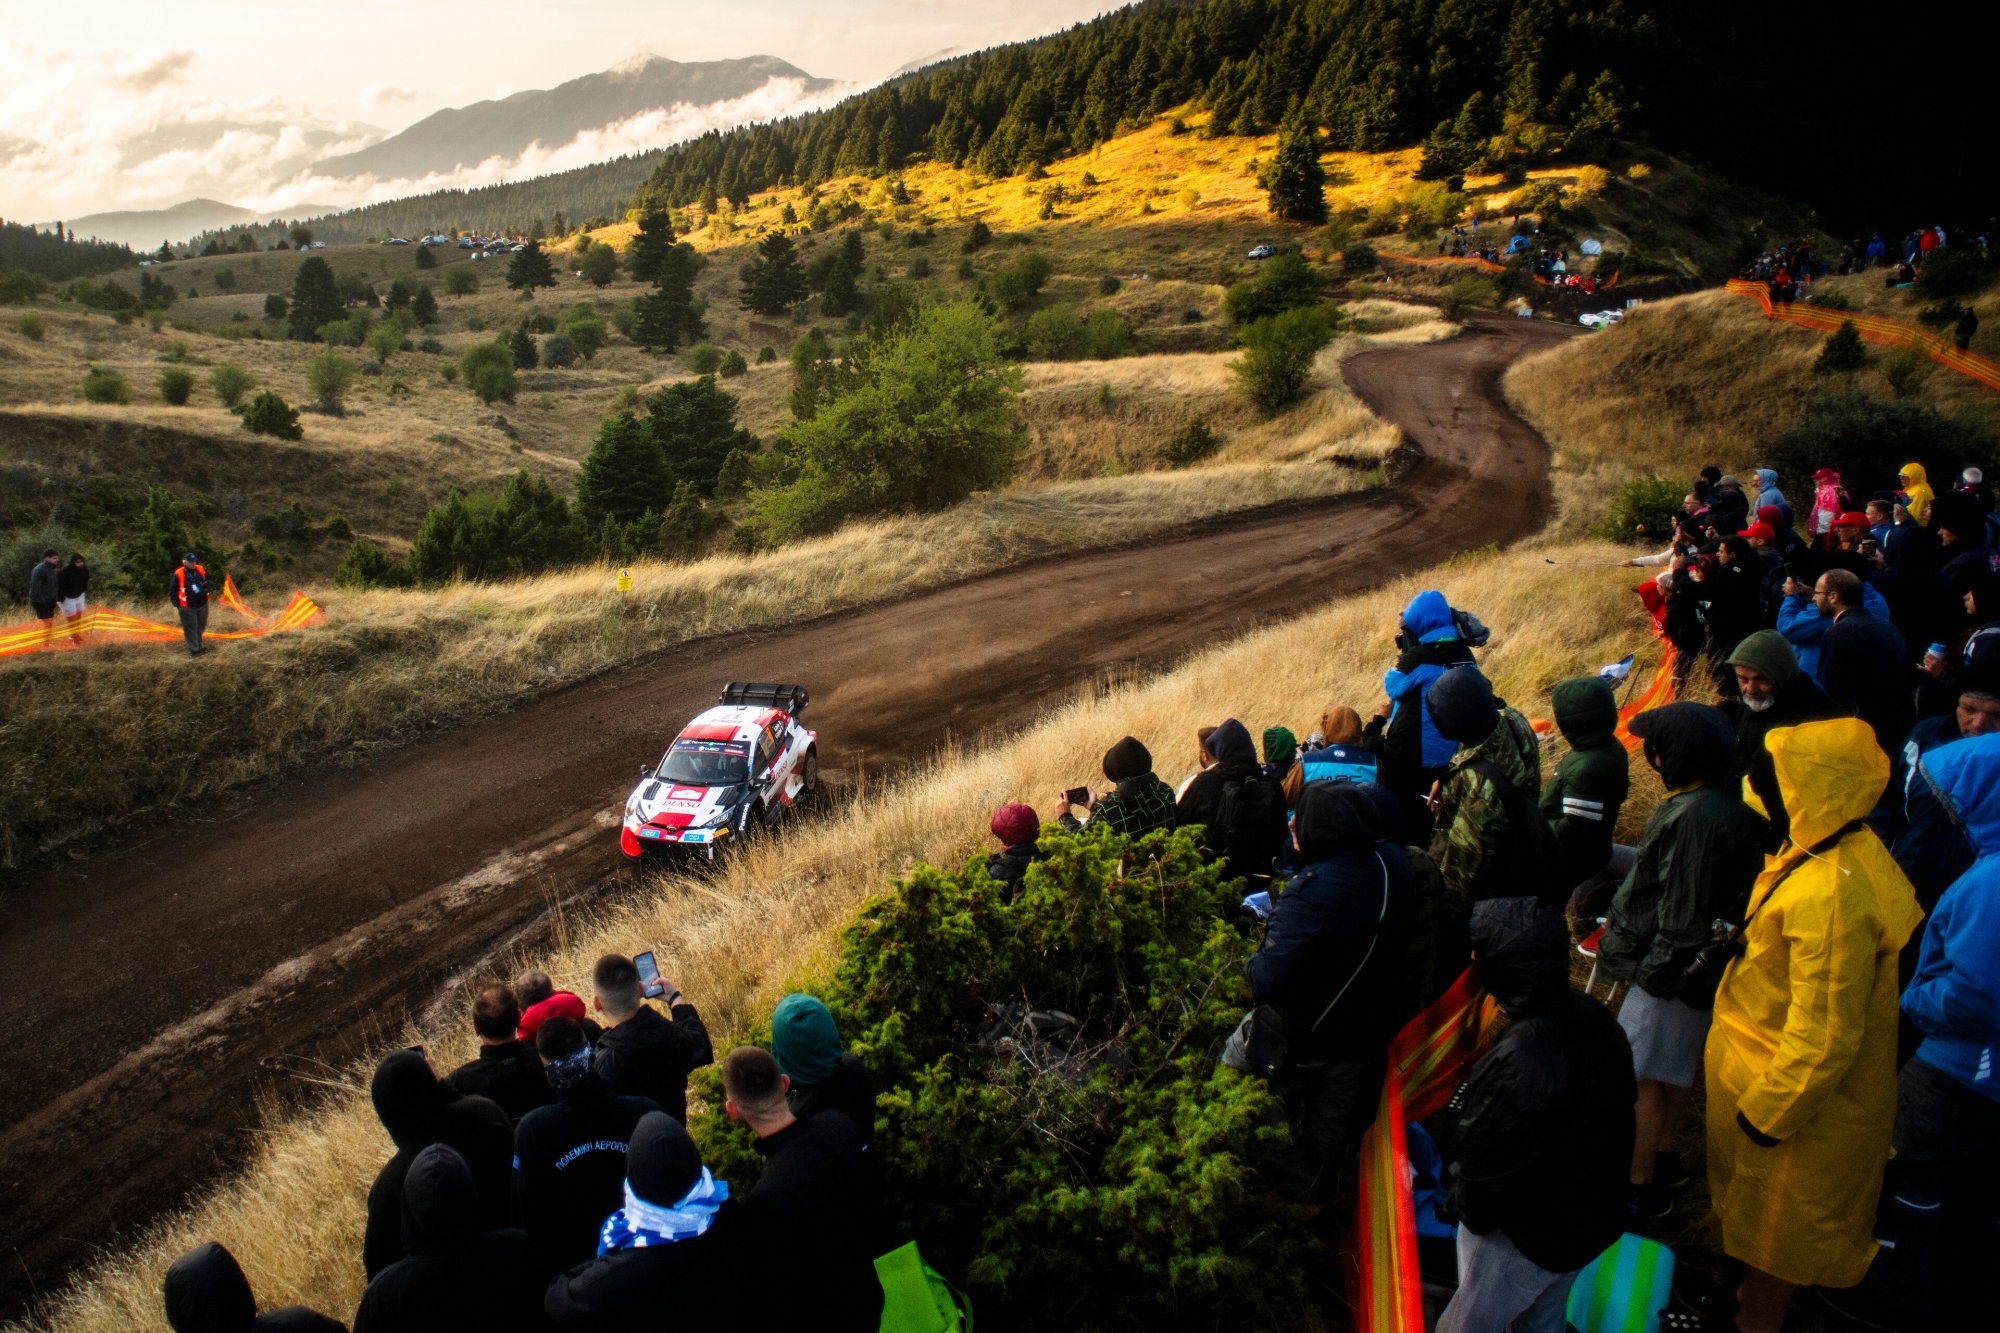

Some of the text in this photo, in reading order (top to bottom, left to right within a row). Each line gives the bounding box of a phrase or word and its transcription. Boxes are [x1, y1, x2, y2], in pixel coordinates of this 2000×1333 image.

[662, 800, 701, 808] DENSO
[555, 1140, 629, 1171] ΠΟΛΕΜΙΚΗ ΑΕΡΟΠΟ
